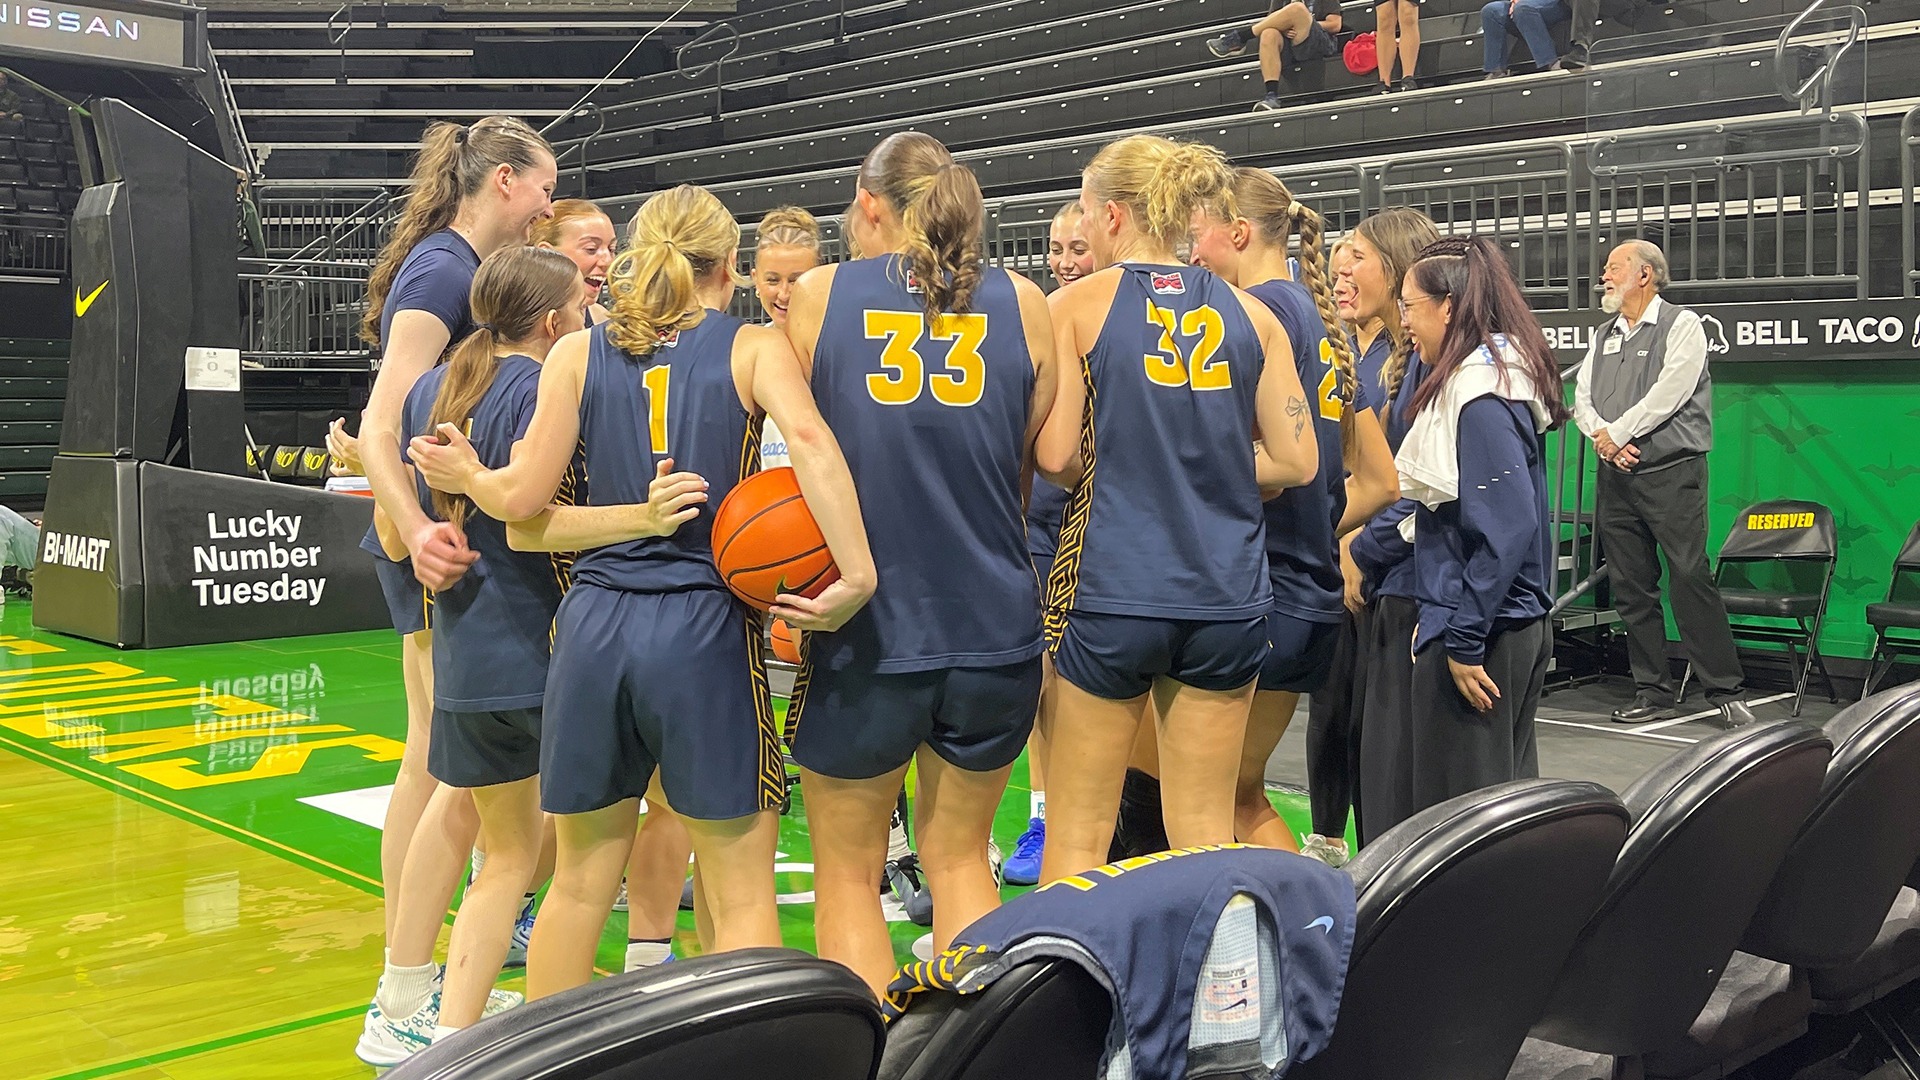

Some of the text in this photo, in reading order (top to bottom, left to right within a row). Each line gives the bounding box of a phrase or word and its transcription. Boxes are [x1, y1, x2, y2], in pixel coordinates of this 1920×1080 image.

[1143, 297, 1233, 391] 32
[1736, 319, 1809, 346] BELL
[1818, 316, 1904, 344] TACO
[863, 308, 988, 407] 33
[642, 363, 671, 454] 1
[207, 509, 302, 542] Lucky
[1747, 512, 1815, 530] RESERVED
[193, 541, 322, 573] Number
[191, 573, 327, 607] Tuesday
